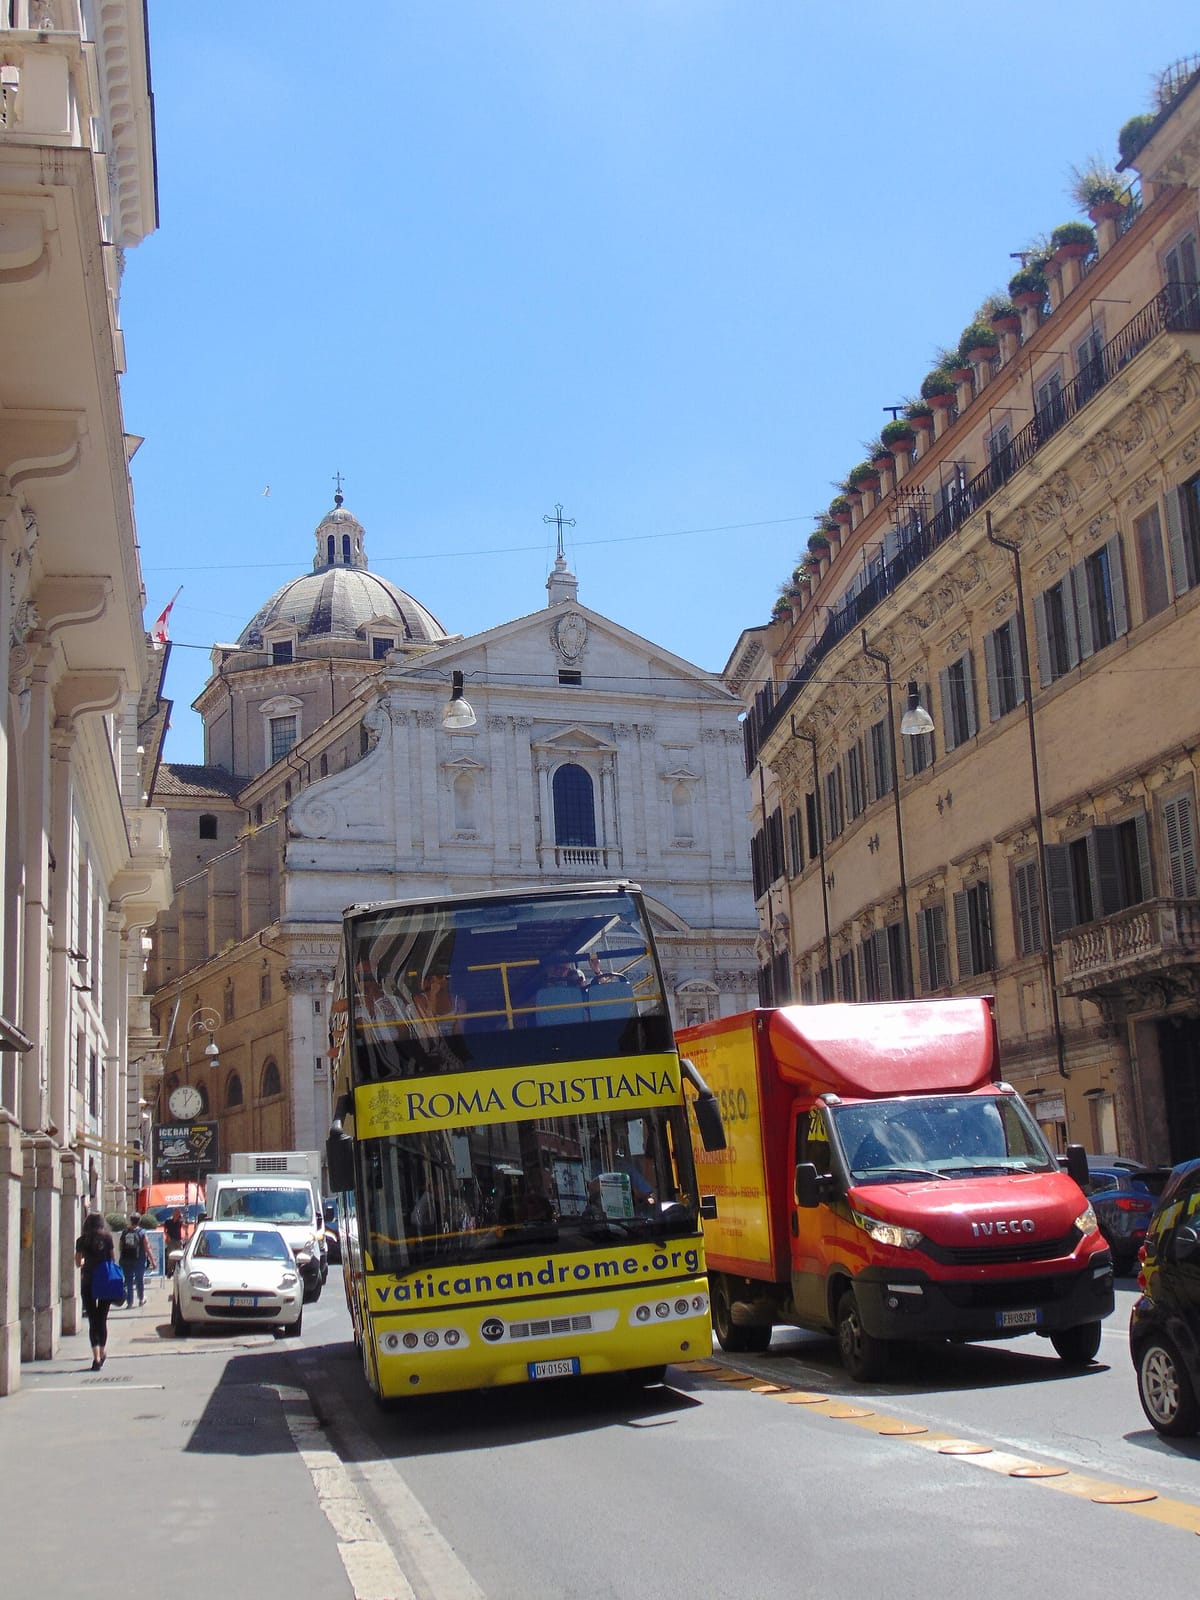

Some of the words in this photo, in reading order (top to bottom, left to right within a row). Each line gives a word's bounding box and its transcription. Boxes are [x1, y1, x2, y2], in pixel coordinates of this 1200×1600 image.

[405, 1086, 506, 1121] ROMA
[511, 1071, 677, 1108] CRISTIANA
[971, 1219, 1035, 1237] IVECO
[375, 1249, 699, 1304] vaticanandrome.org
